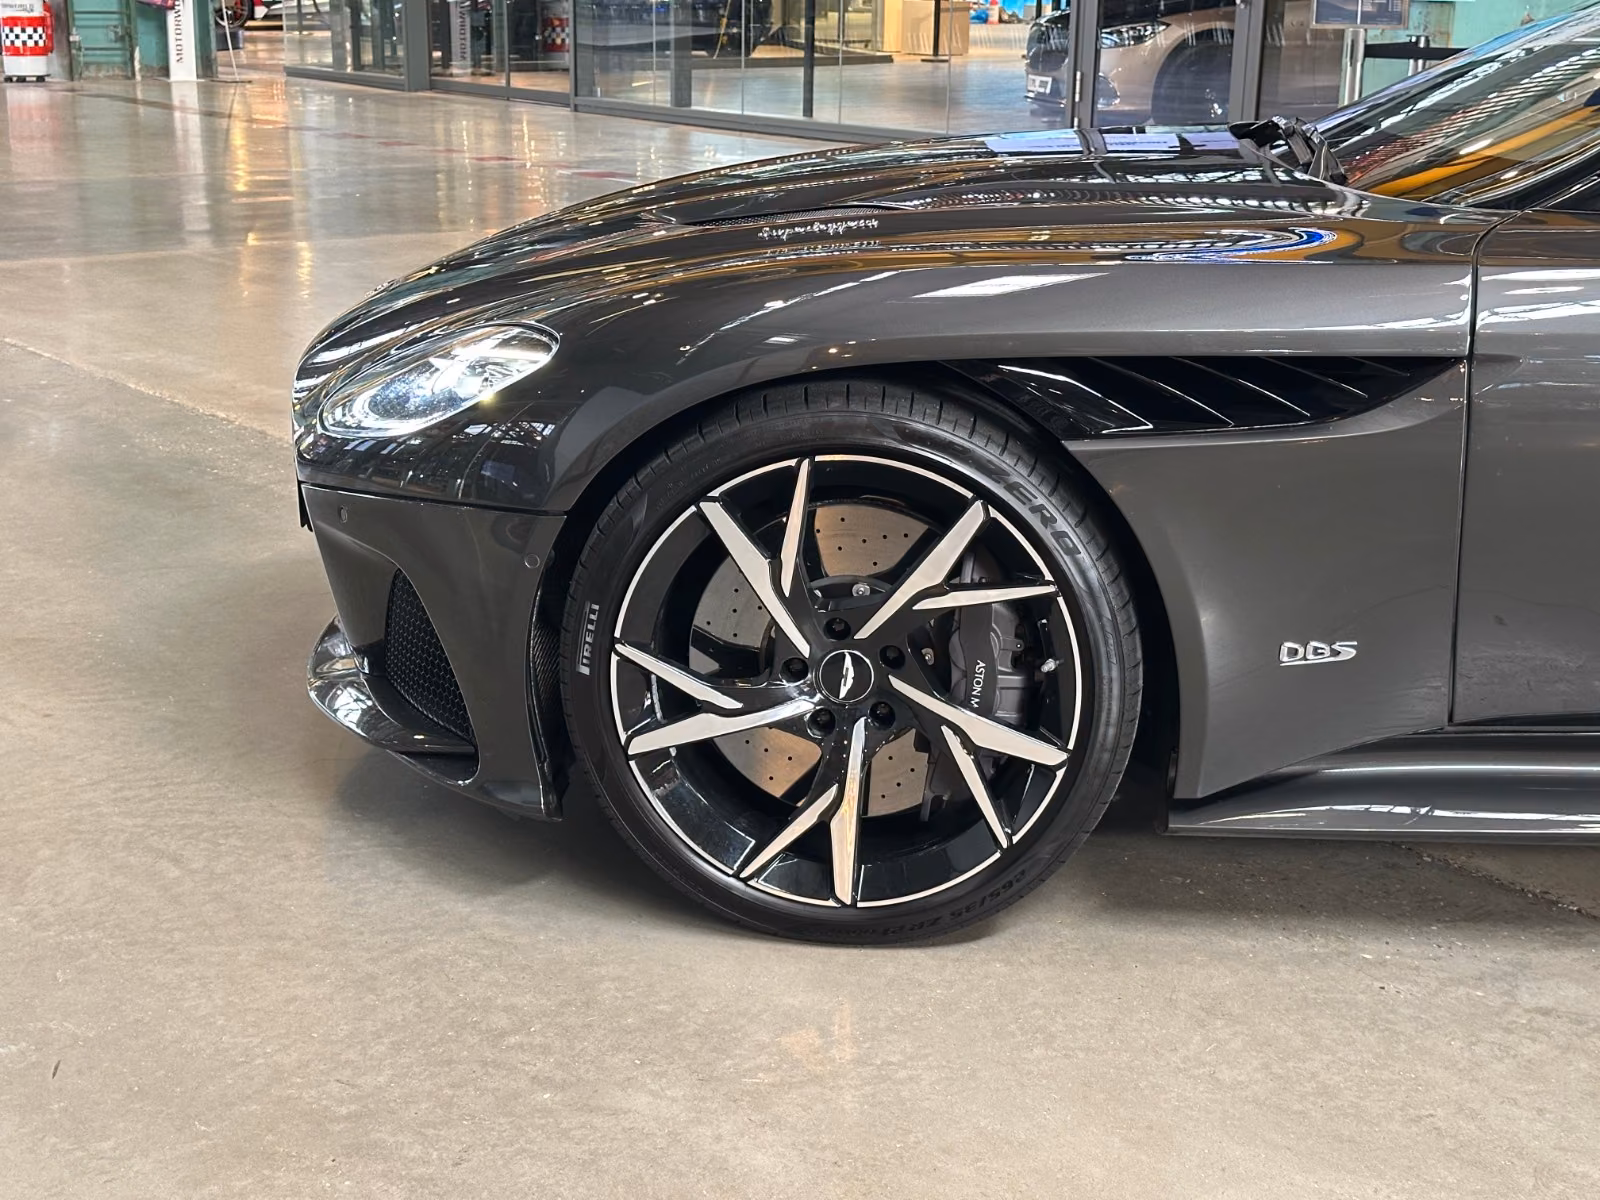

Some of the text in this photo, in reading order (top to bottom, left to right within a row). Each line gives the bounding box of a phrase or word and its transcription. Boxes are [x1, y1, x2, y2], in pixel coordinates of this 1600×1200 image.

[975, 458, 1081, 556] ZERO
[576, 601, 600, 676] PIRELLI
[1279, 641, 1358, 667] DBS
[971, 660, 986, 696] ASTON
